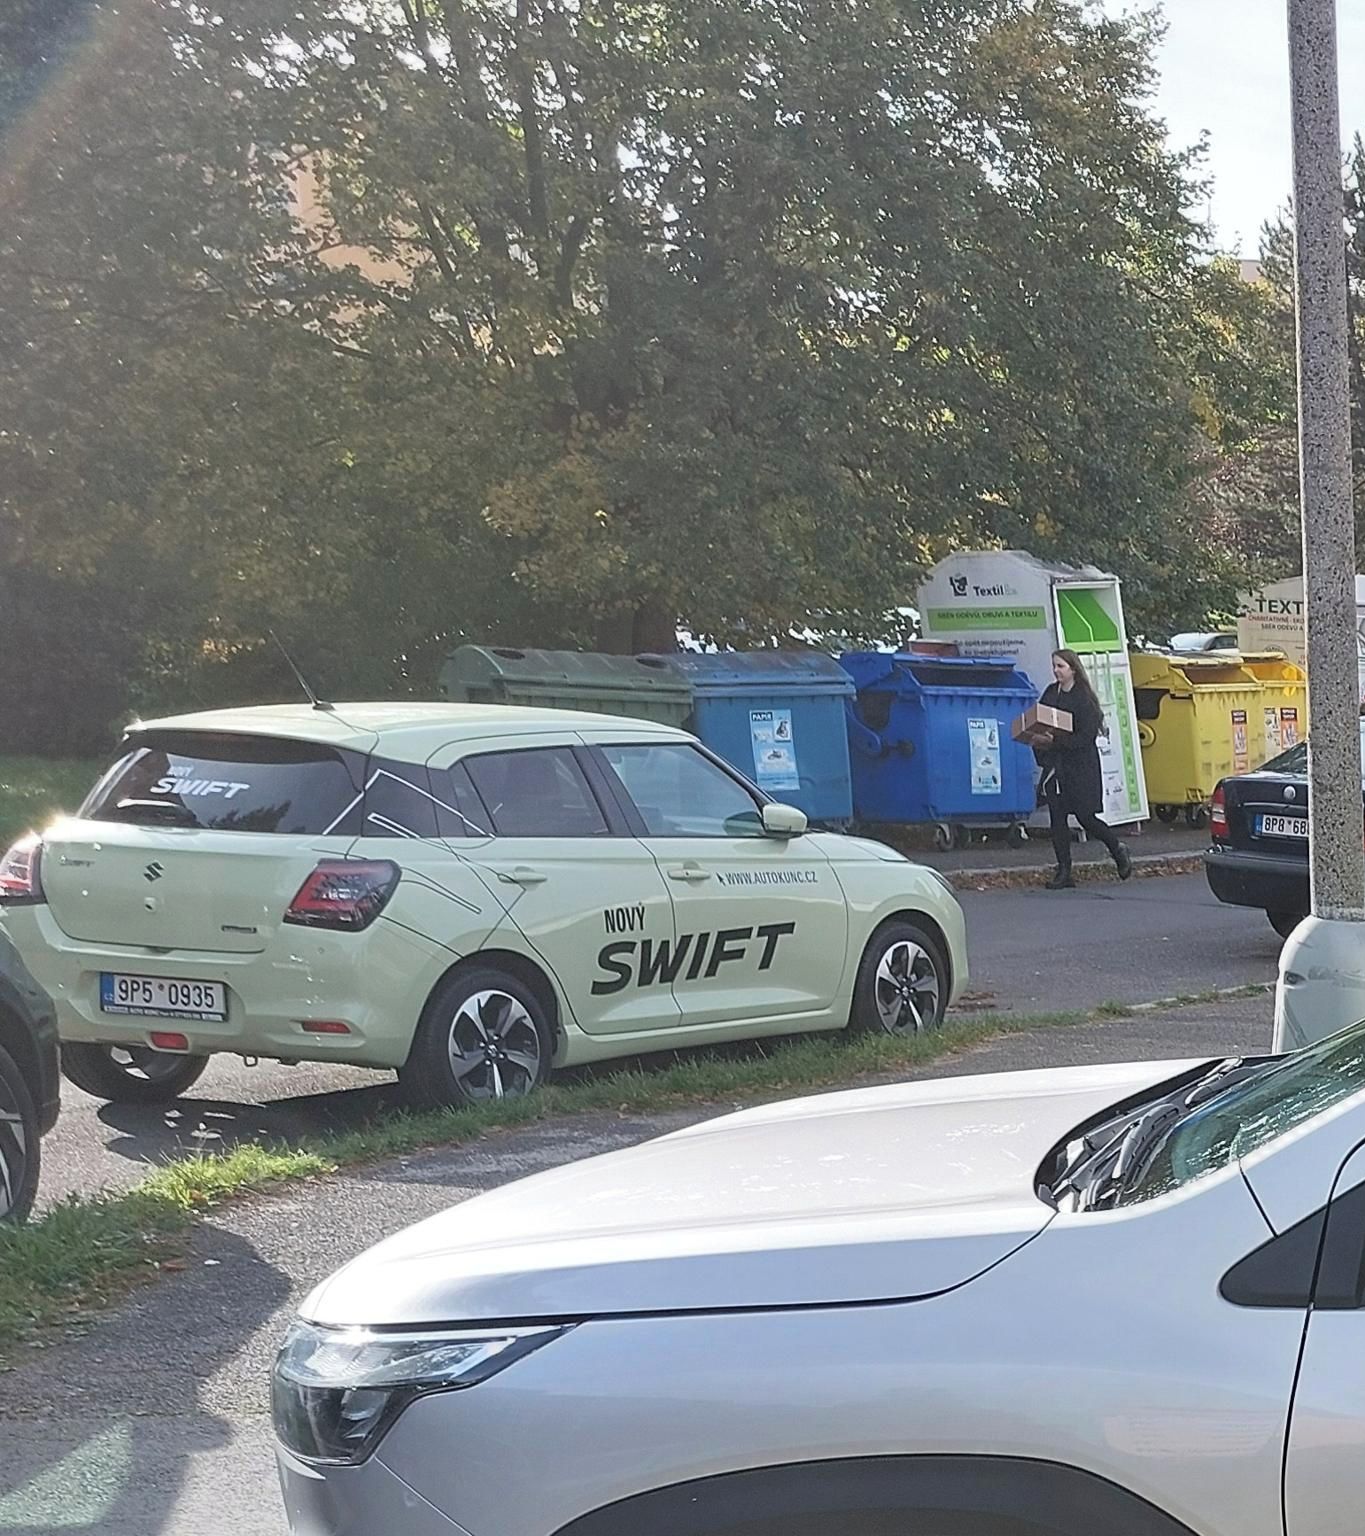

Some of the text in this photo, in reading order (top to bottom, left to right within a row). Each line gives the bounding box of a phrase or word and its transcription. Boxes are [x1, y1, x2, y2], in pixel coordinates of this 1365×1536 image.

[150, 777, 250, 799] SWIFT
[1293, 820, 1309, 835] 68
[725, 871, 818, 885] WWW.AUTOKUNC.CZ
[604, 902, 646, 934] NOVÝ
[590, 921, 796, 996] SWIFT
[118, 979, 215, 1009] 9P5 0935
